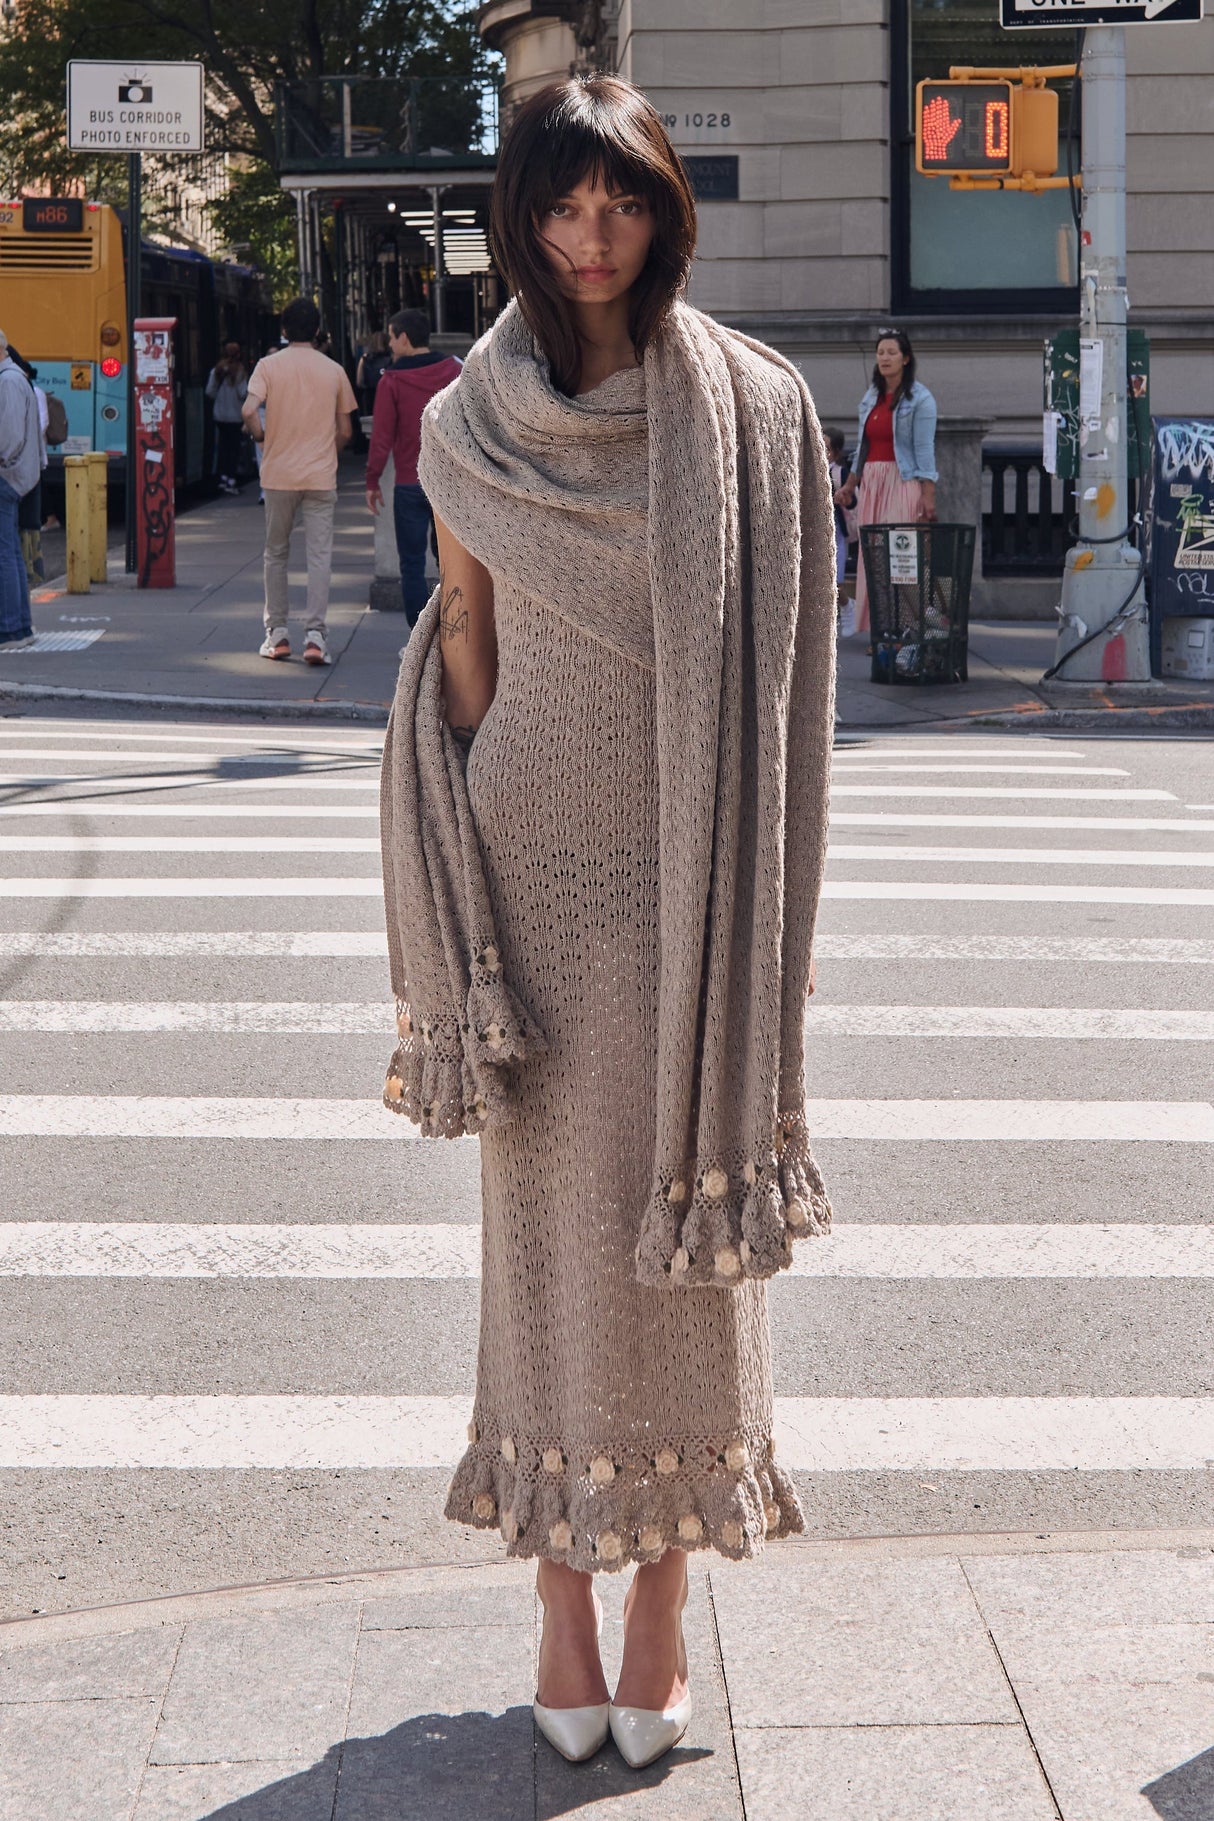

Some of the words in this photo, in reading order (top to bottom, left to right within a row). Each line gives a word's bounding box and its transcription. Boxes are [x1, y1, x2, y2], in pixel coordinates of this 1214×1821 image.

[89, 110, 114, 123] BUS
[120, 111, 182, 124] CORRIDOR
[685, 112, 731, 128] 1028
[81, 130, 121, 143] PHOTO
[125, 131, 191, 144] ENFORCED
[985, 102, 1009, 158] 0
